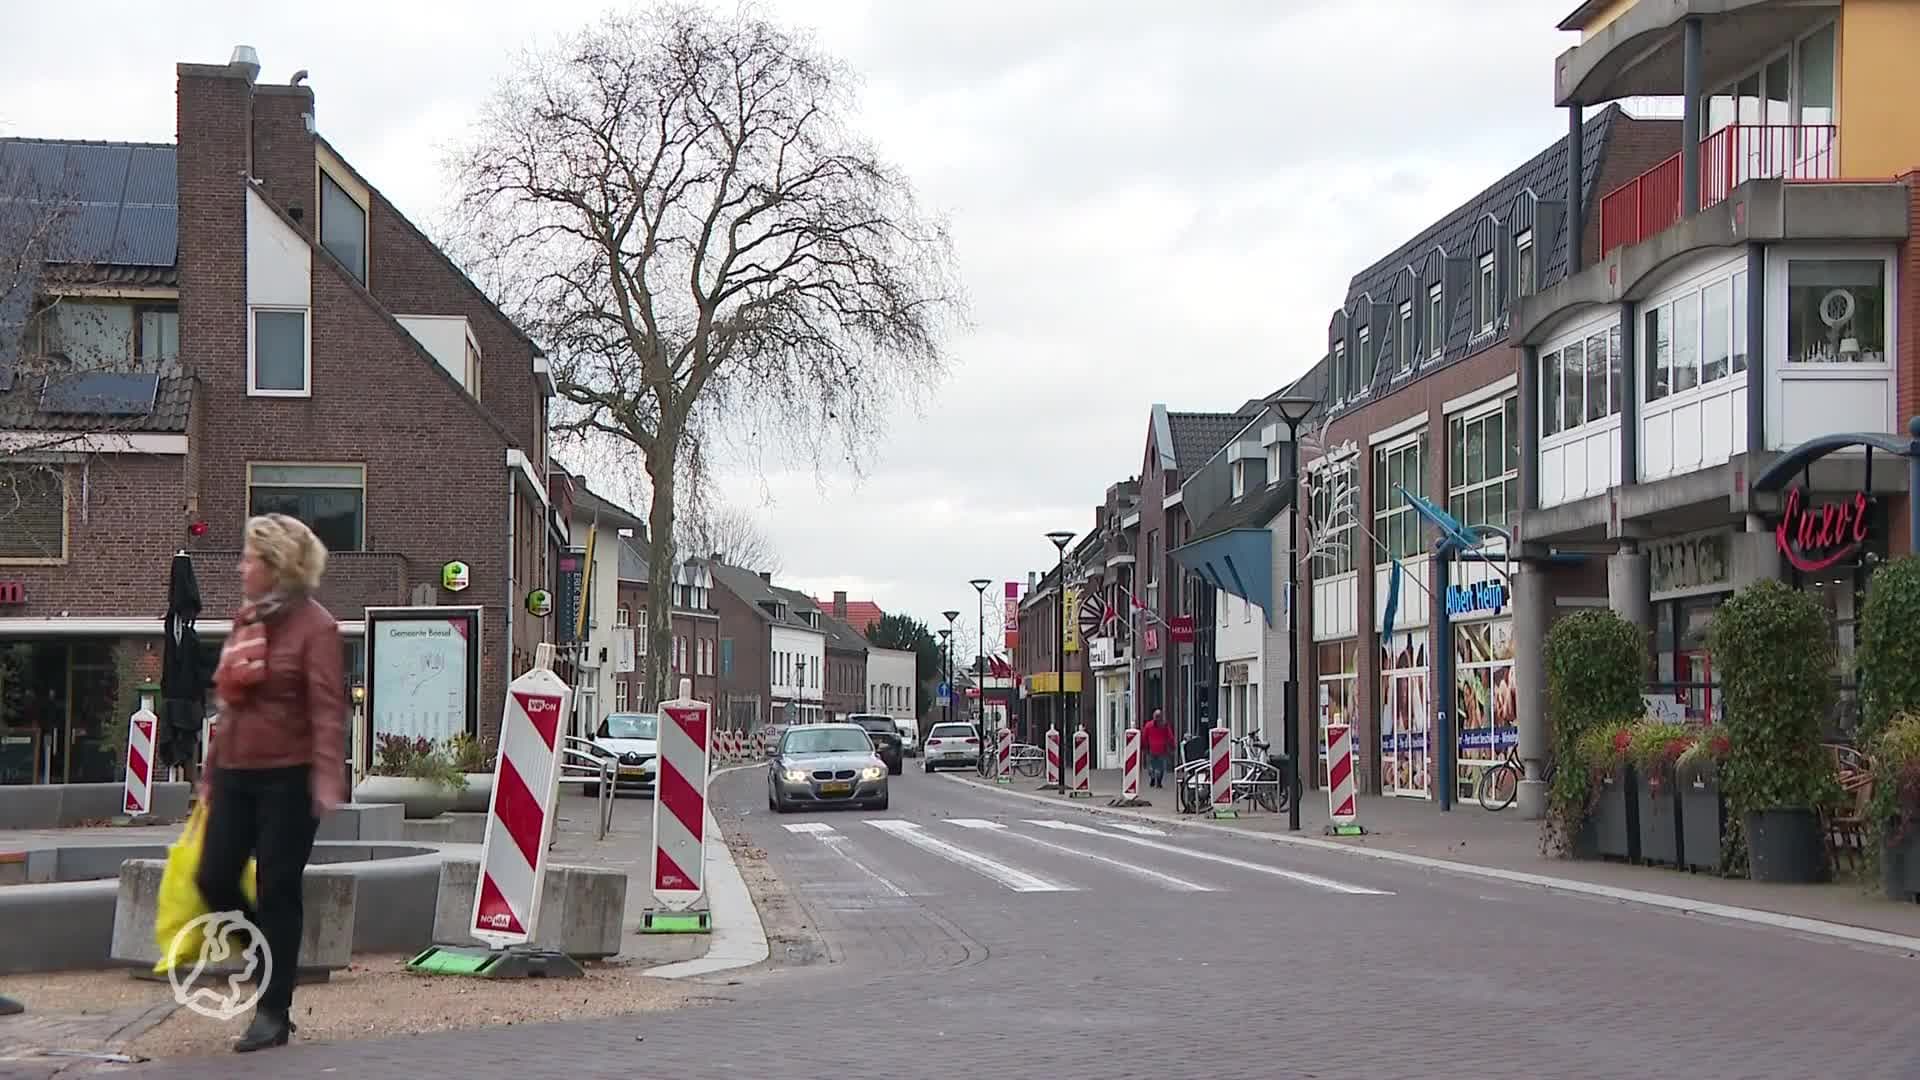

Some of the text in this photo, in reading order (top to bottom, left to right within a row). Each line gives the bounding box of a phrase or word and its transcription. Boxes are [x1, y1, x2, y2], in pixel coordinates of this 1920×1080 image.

[1776, 487, 1868, 572] Luxor
[1445, 581, 1503, 616] Albert Heijn
[390, 628, 427, 637] Gemeente
[428, 627, 451, 637] Beesel
[1171, 626, 1193, 634] HEMA
